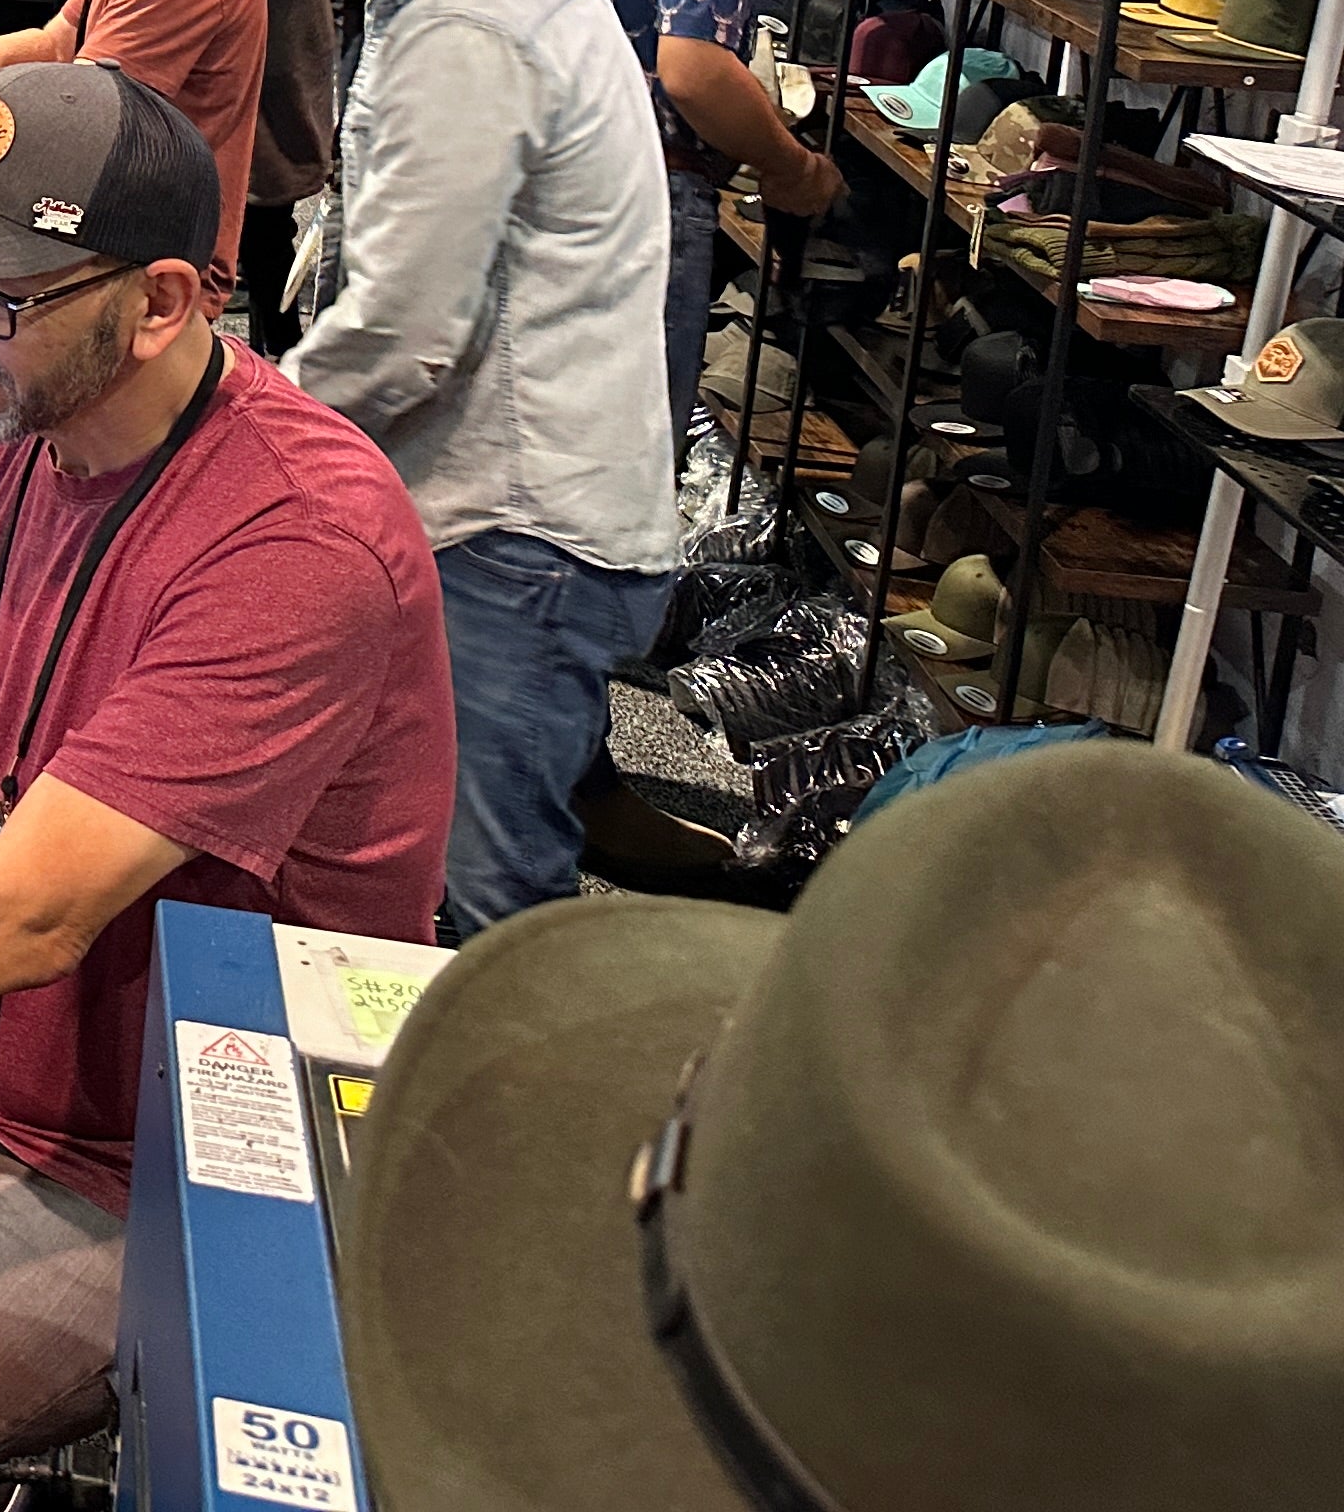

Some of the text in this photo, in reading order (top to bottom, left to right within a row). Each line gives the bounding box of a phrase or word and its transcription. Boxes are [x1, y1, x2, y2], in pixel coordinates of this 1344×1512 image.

[188, 1067, 289, 1090] FIRE HAZARD
[198, 1058, 275, 1078] DANGER
[240, 1410, 320, 1450] 50
[251, 1440, 315, 1462] WATTS
